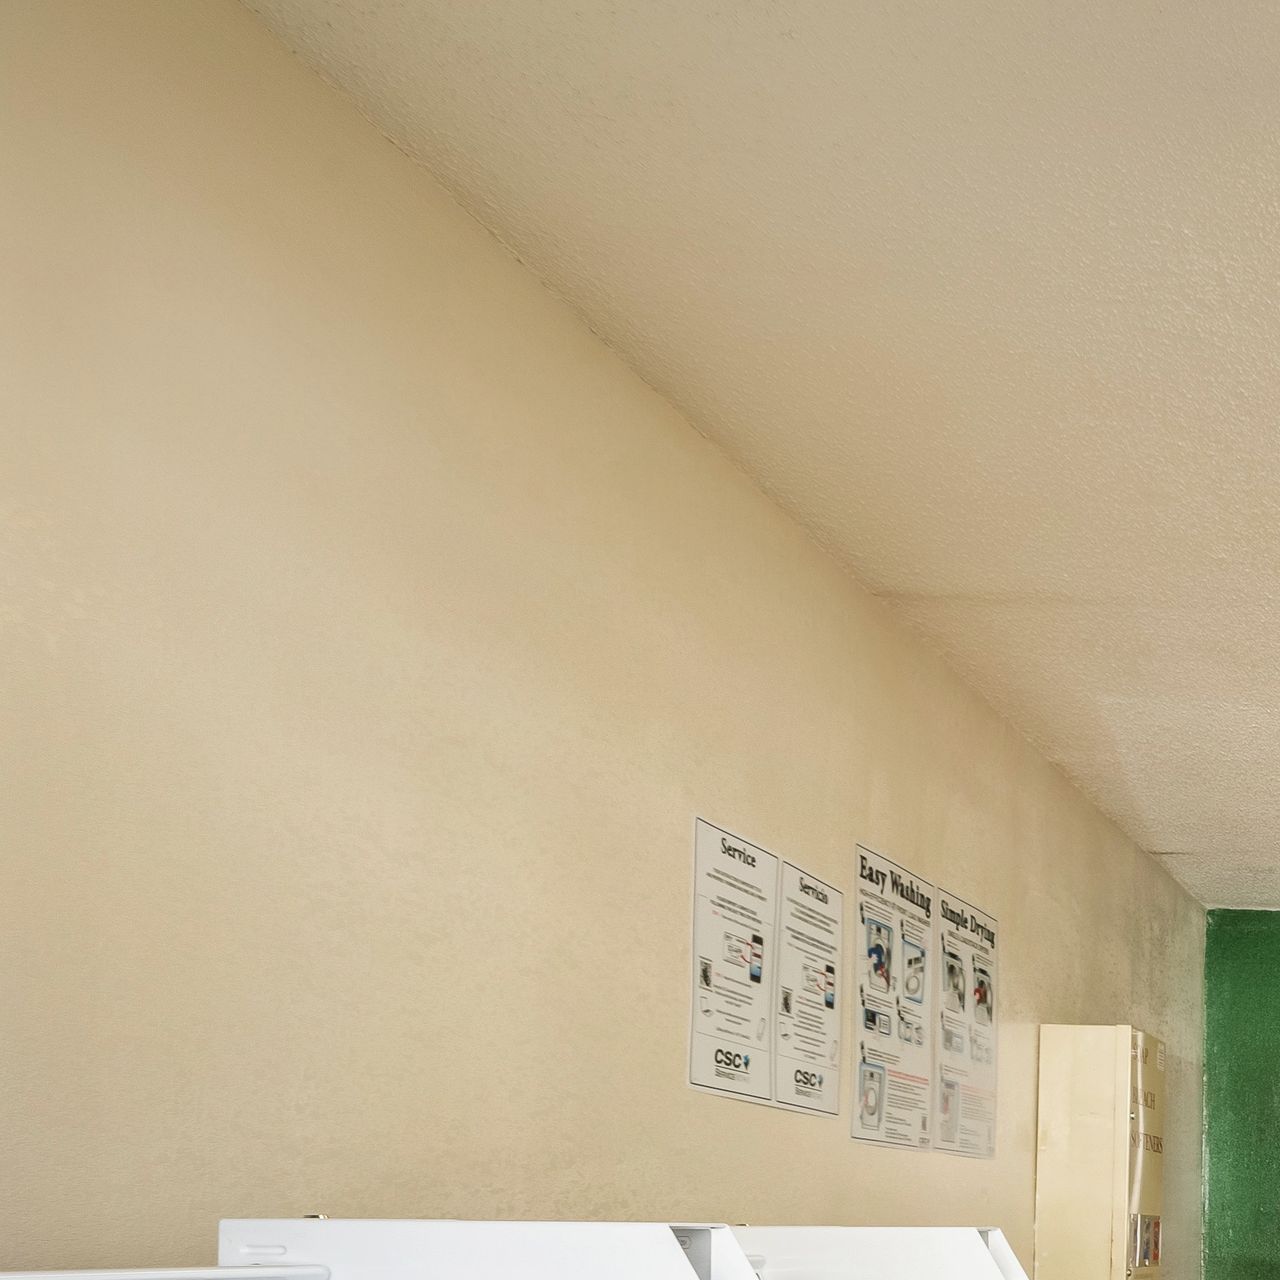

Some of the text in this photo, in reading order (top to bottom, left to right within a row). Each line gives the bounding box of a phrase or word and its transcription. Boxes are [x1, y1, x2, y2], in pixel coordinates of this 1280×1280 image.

[721, 837, 756, 868] Service
[859, 854, 887, 895] Easy
[889, 870, 931, 919] Washing
[941, 899, 968, 931] Simple
[970, 914, 995, 950] Drying
[714, 1048, 742, 1069] CSC
[793, 1069, 817, 1087] CSC
